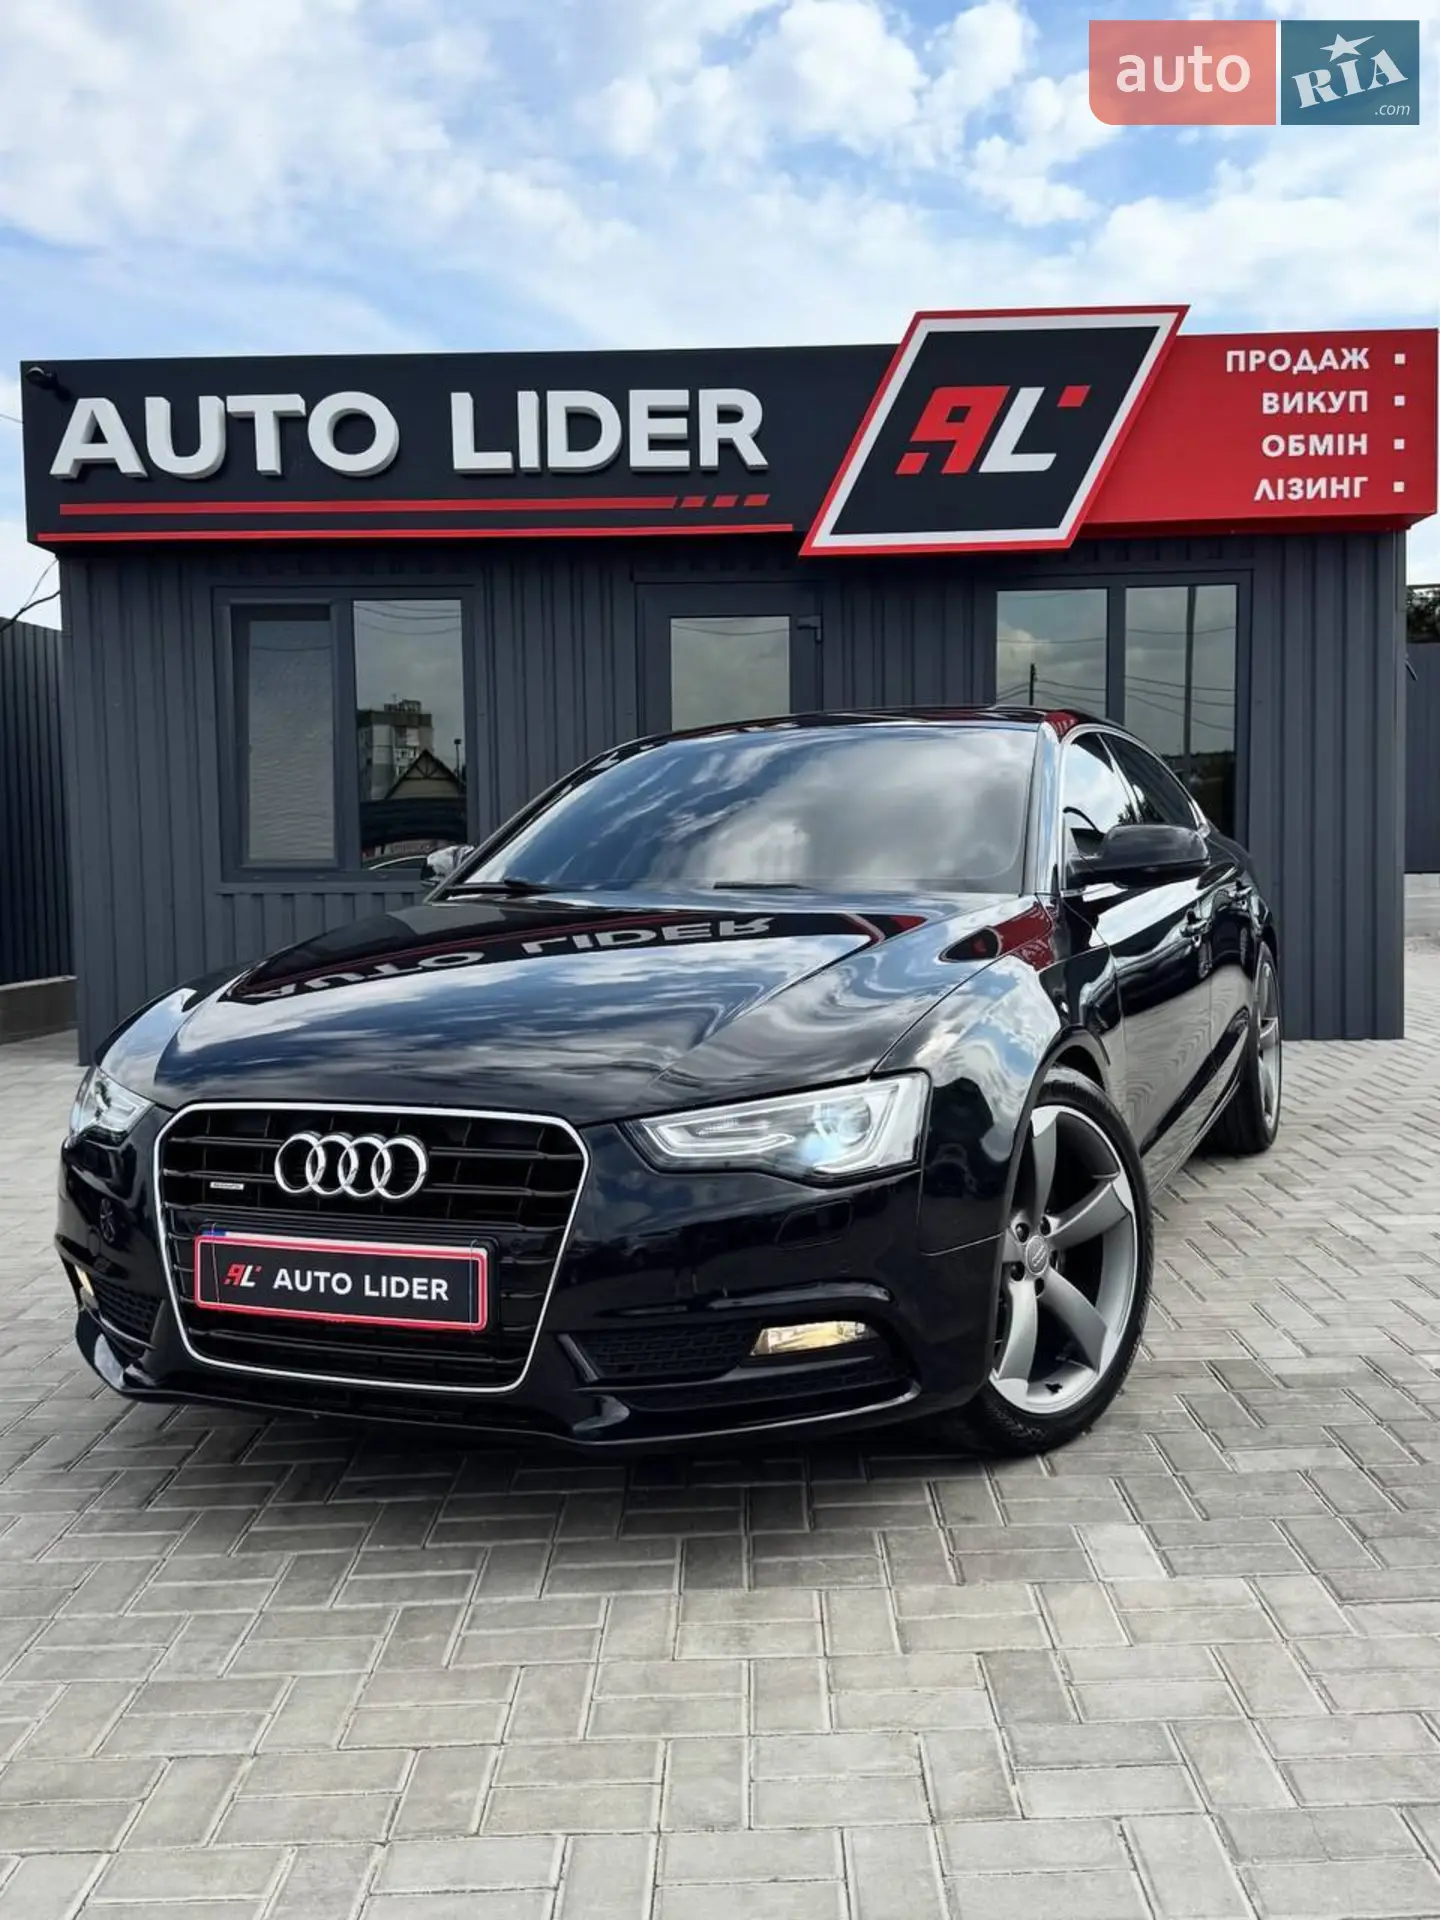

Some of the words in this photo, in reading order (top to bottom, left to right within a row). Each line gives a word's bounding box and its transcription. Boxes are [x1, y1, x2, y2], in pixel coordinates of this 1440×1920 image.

[1226, 347, 1370, 375] ПРОДАЖ
[1262, 390, 1368, 414] ВИКУП
[50, 391, 400, 480] AUTO
[450, 387, 769, 475] LIDER
[1261, 433, 1368, 457] ОБМІН
[1254, 476, 1369, 501] ЛІЗИНГ
[273, 1268, 352, 1295] AUTO
[363, 1275, 449, 1301] LIDER
